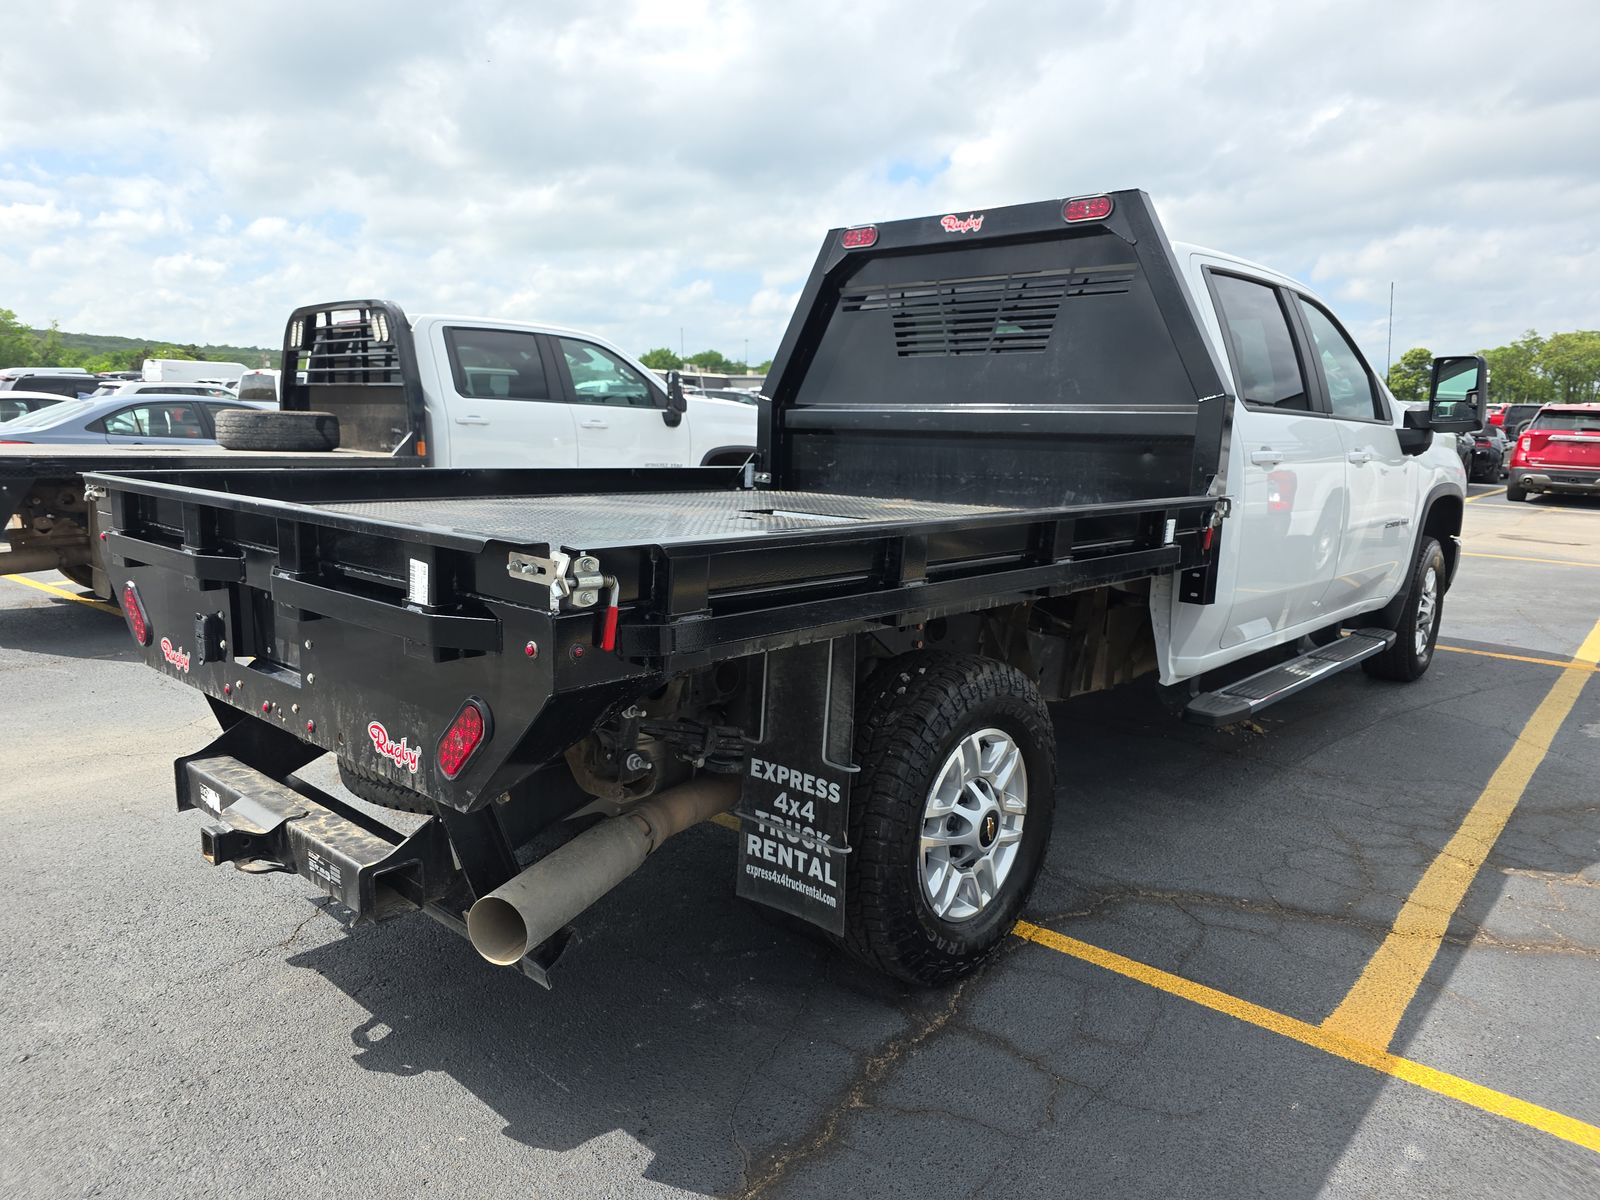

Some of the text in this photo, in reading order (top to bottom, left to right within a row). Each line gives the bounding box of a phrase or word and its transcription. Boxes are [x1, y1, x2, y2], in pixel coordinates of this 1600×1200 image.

[941, 215, 984, 233] Rugby
[161, 637, 190, 673] Rugby
[368, 721, 420, 773] Rugby
[751, 758, 841, 803] EXPRESS
[774, 792, 815, 823] 4x4
[755, 809, 831, 857] TRUCK
[747, 834, 837, 887] RENTAL
[746, 864, 837, 908] express4x4truckrental.com
